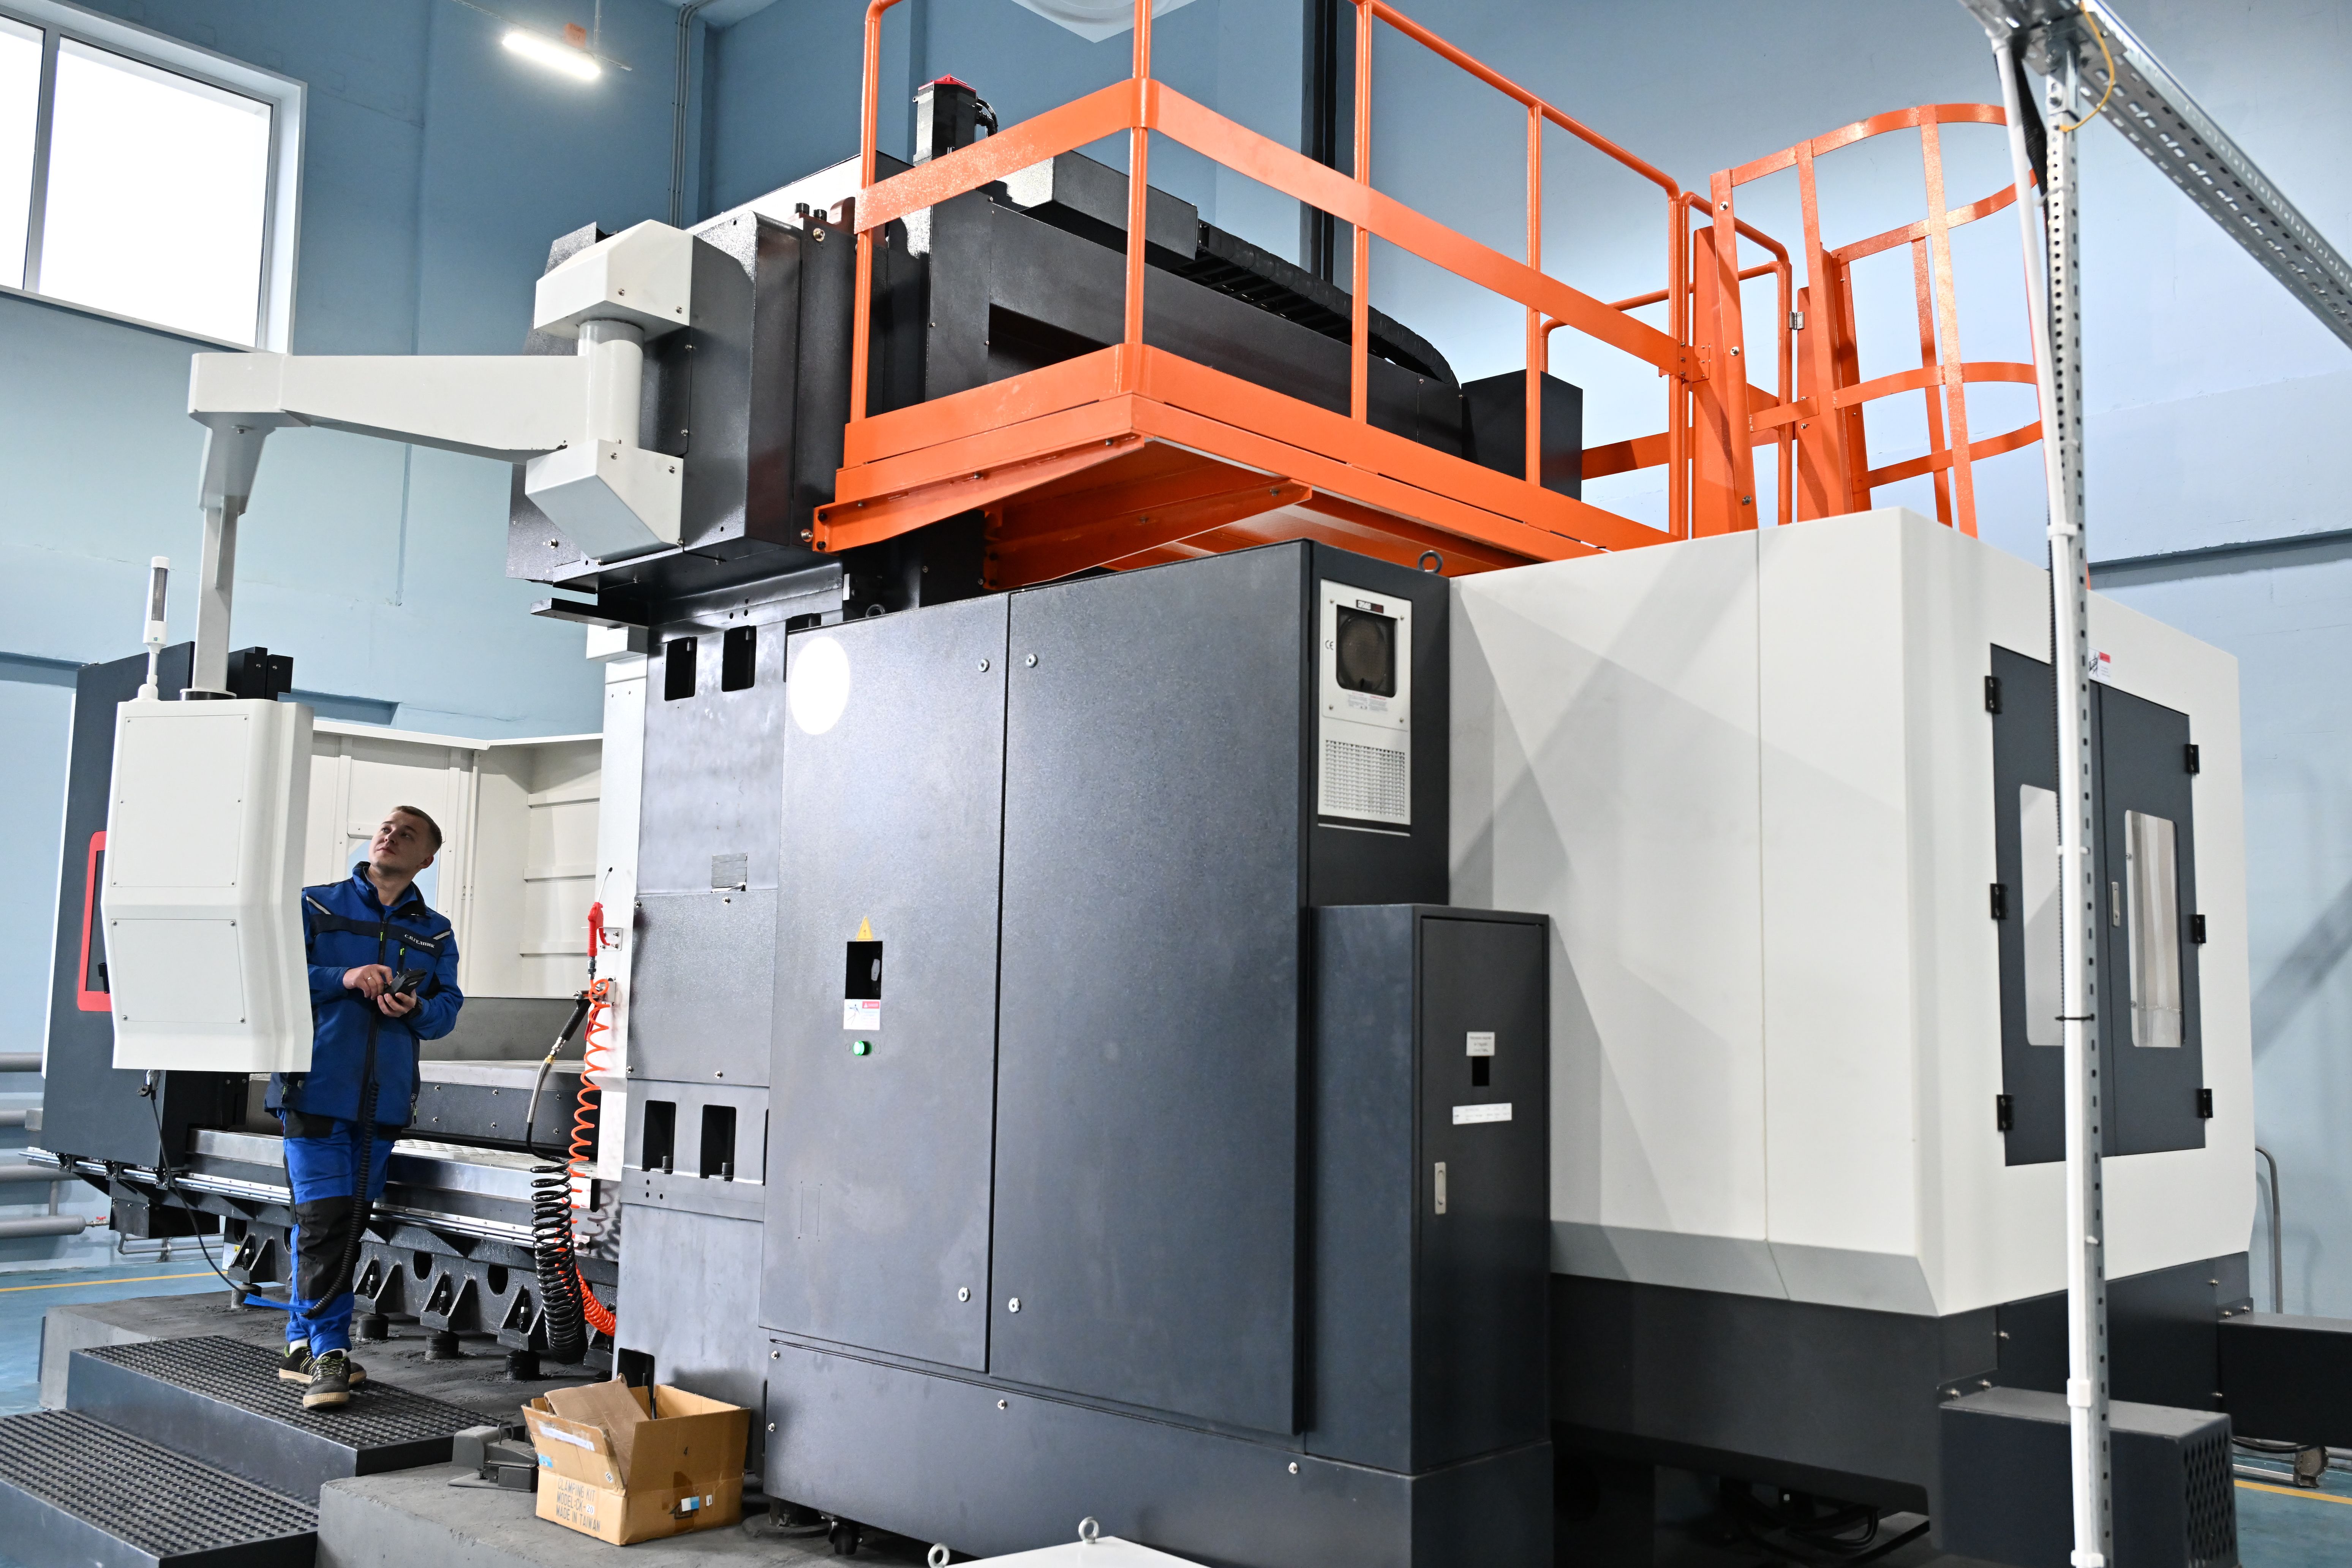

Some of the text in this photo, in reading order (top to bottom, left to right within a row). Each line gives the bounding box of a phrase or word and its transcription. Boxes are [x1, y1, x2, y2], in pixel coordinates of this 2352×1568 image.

[1325, 640, 1334, 650] CE
[558, 1478, 596, 1502] CLAMPING KIT
[556, 1504, 601, 1532] MADE IN TAIWAN
